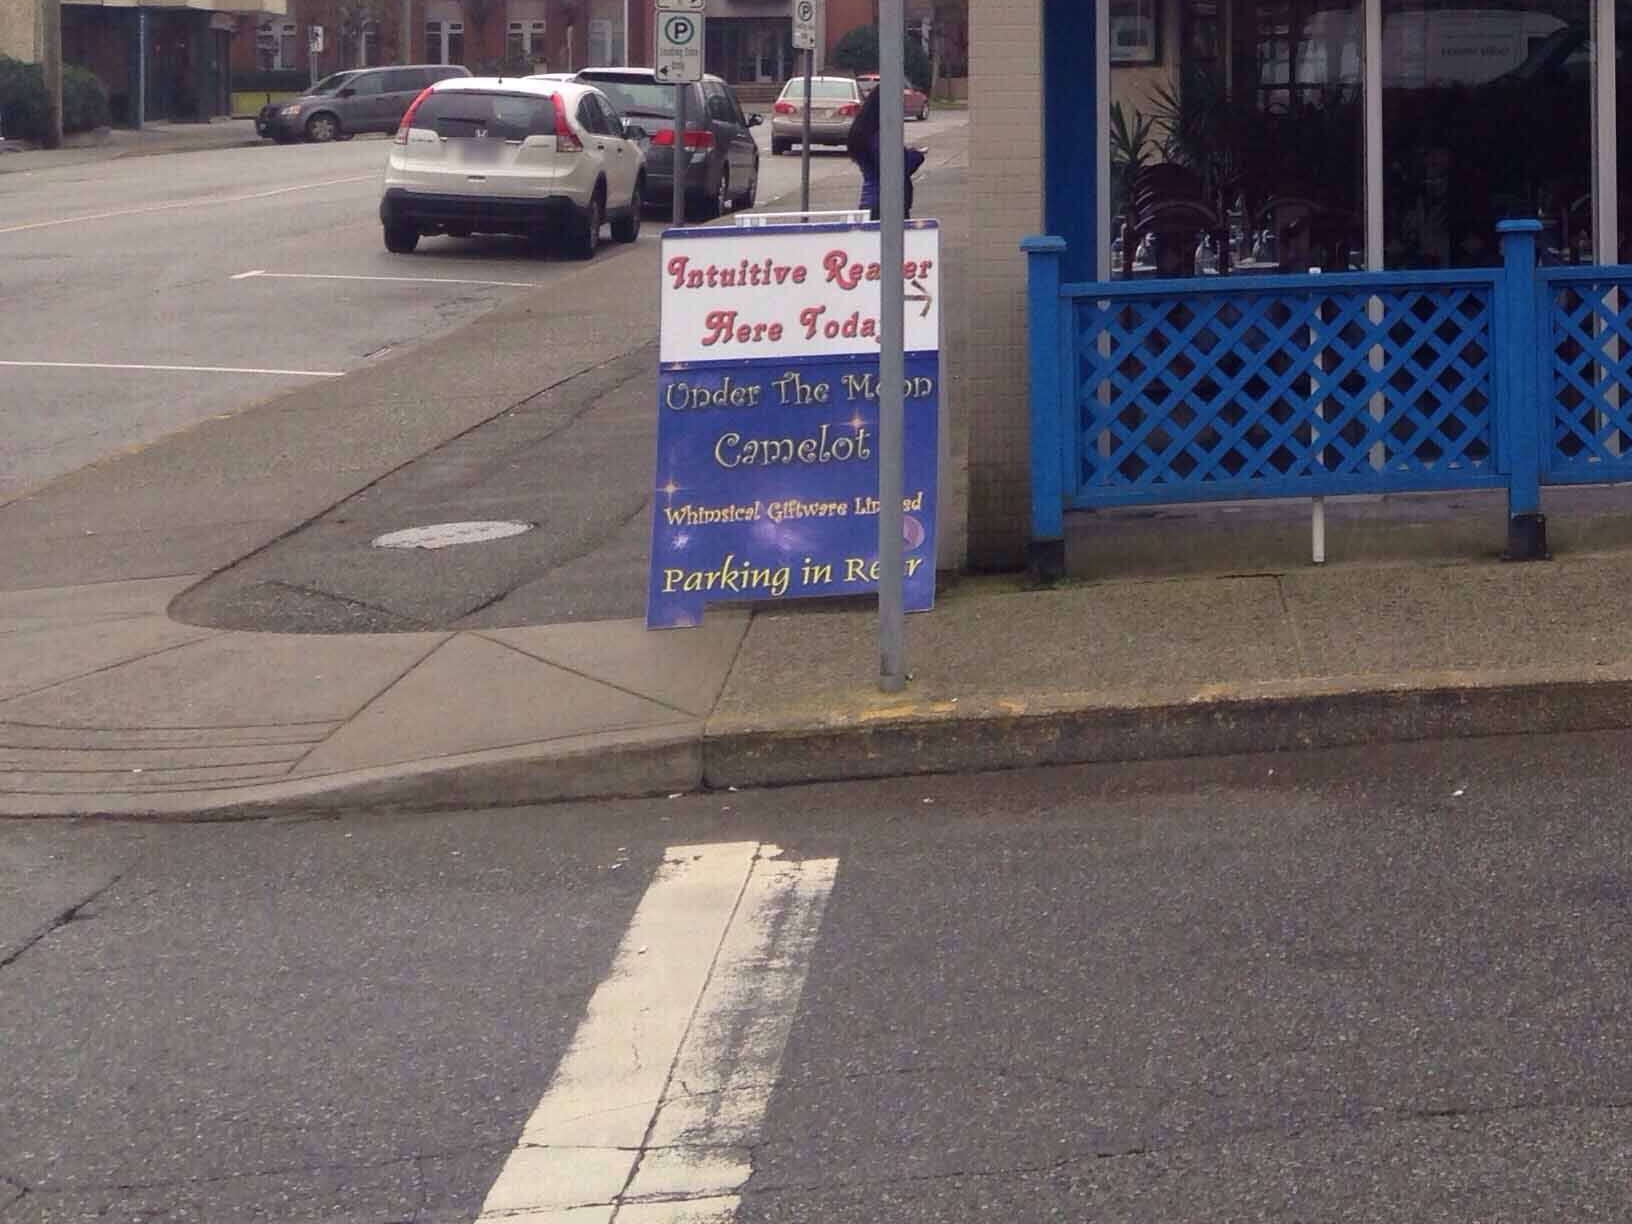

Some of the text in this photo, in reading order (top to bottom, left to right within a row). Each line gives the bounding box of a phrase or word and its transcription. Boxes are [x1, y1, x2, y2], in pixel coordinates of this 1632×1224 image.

[674, 22, 689, 40] P
[667, 249, 932, 290] Intuitive Reaer
[701, 304, 881, 346] Here Toda
[665, 371, 932, 411] Under The Mn
[714, 424, 871, 468] Camelot
[664, 491, 924, 525] Whimsical Giftware Lied
[662, 555, 923, 596] Parking in Rer
